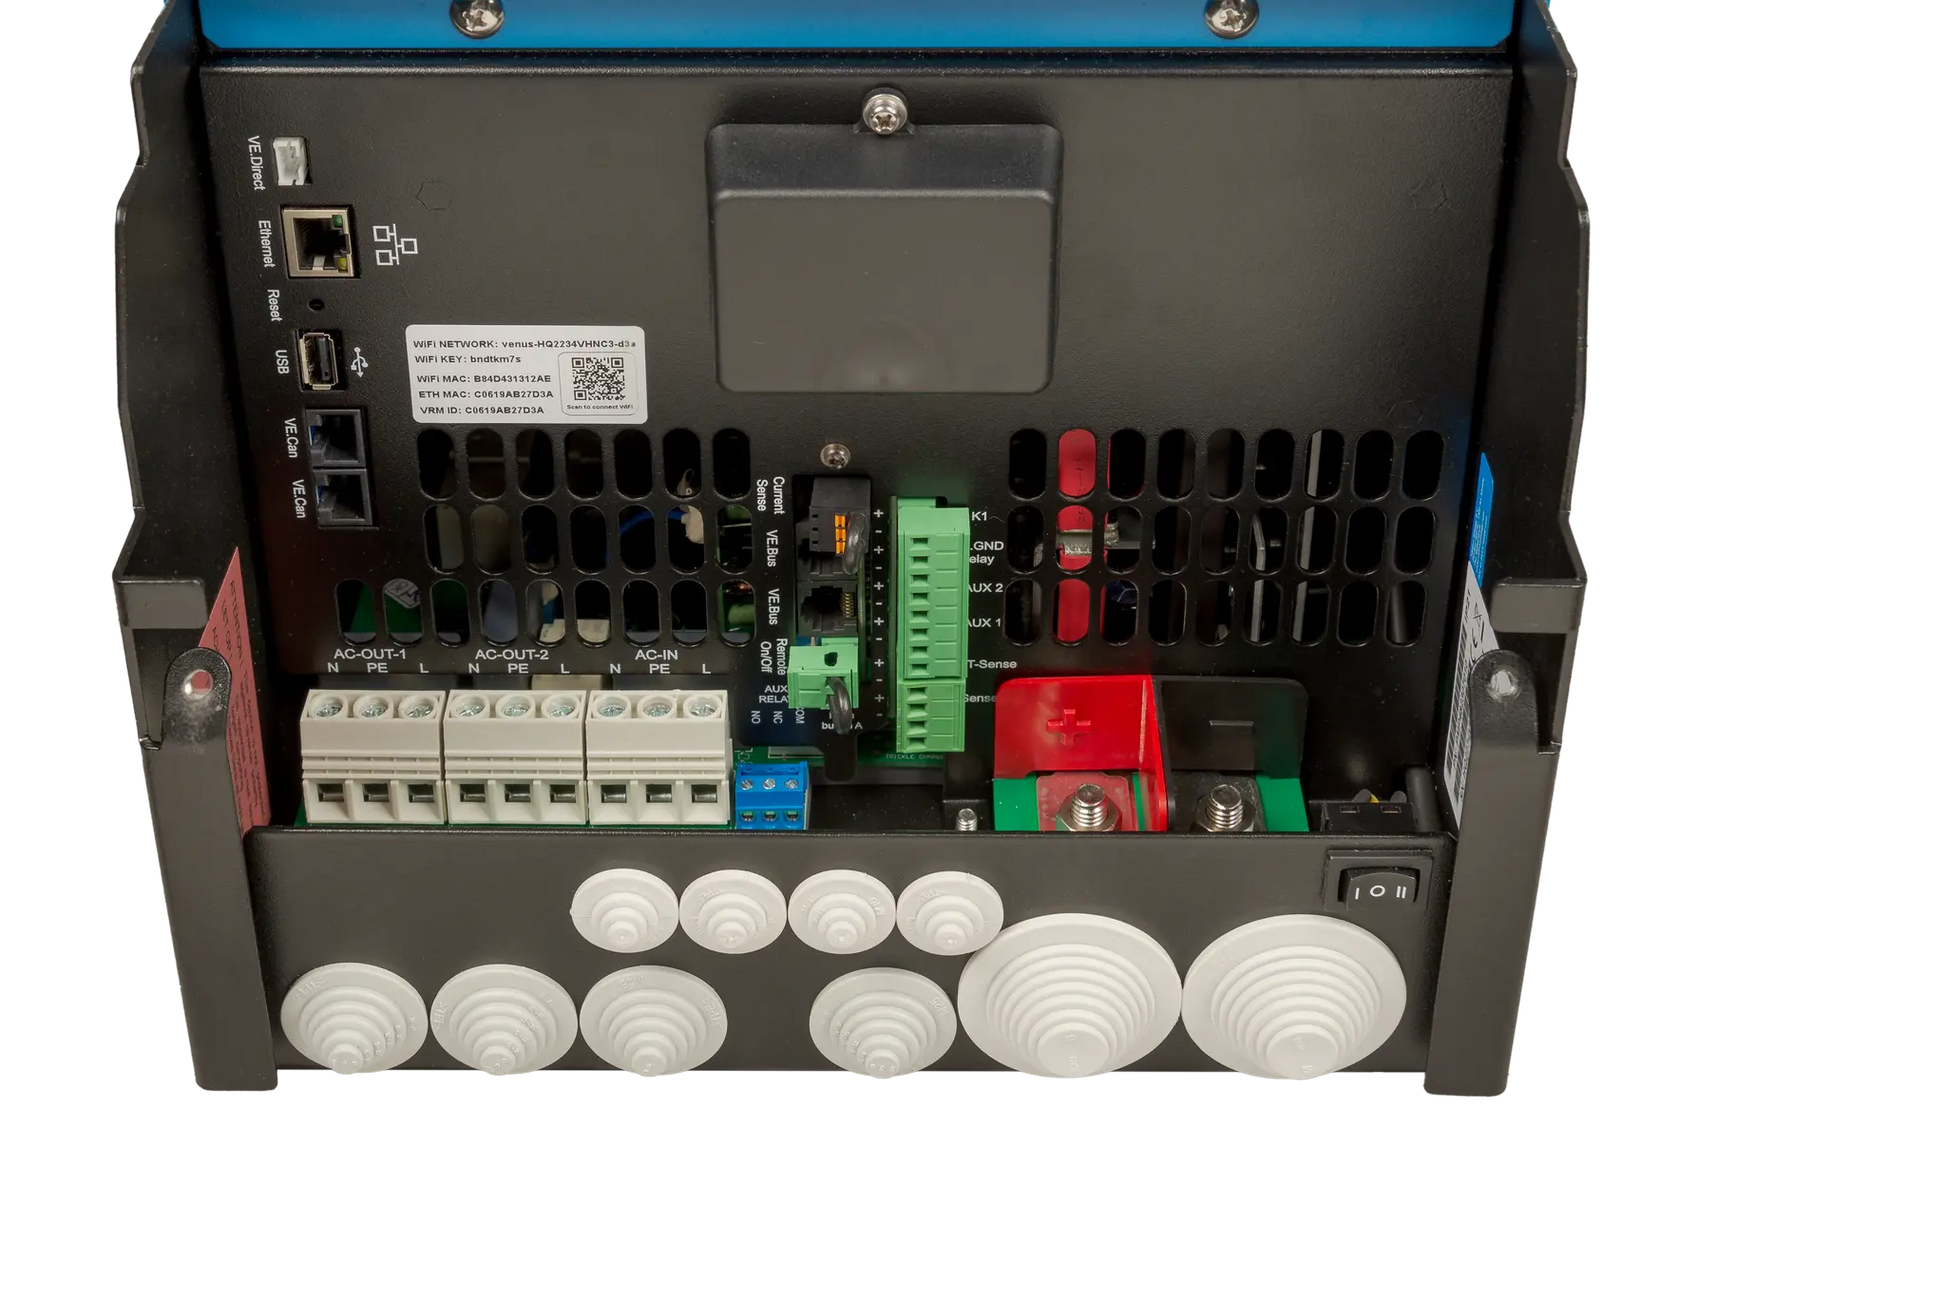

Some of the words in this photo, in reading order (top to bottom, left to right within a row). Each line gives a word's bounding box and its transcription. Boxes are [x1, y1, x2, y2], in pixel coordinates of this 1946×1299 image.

[247, 135, 266, 191] VE.Direct
[258, 220, 275, 268] Ethernet
[267, 289, 282, 322] Reset
[413, 340, 437, 349] WiFi
[439, 340, 499, 349] NETWORK:
[275, 349, 290, 375] USB
[414, 355, 438, 364] WiFi
[440, 355, 467, 364] KEY:
[470, 355, 521, 364] bndtkm7s
[416, 375, 440, 383] WiFi
[442, 375, 471, 384] MAC:
[473, 375, 551, 383] B84D431312AE
[418, 390, 441, 399] ETH
[442, 390, 471, 399] MAC:
[474, 390, 554, 399] C0619AB27D3A
[419, 406, 445, 415] VRM
[447, 406, 462, 415] ID:
[464, 406, 545, 415] C0619AB27D3A
[284, 417, 299, 458] VE.Can
[292, 479, 307, 519] VE.Can
[756, 479, 768, 512] Sense
[773, 476, 786, 515] Current
[766, 529, 778, 567] VE.Bus
[969, 540, 1005, 551] .GND
[968, 554, 995, 566] elay
[995, 583, 1004, 593] 2
[768, 588, 780, 626] VE.Bus
[995, 618, 1001, 627] 1
[333, 649, 407, 660] AC-OUT-1
[474, 649, 549, 661] AC-OUT-2
[634, 649, 679, 661] AC-IN
[760, 641, 773, 674] On/Off
[776, 637, 788, 676] Remote
[328, 662, 339, 674] N
[366, 662, 389, 674] PE
[419, 662, 430, 674] L
[468, 662, 480, 674] N
[507, 662, 529, 674] PE
[560, 662, 570, 674] L
[609, 662, 621, 674] N
[649, 662, 671, 674] PE
[702, 662, 712, 674] L
[967, 659, 1018, 669] T-Sense
[764, 684, 788, 693] AUX
[758, 695, 788, 704] RELA
[965, 694, 996, 703] Sense
[751, 710, 761, 725] NO
[773, 710, 783, 725] NC
